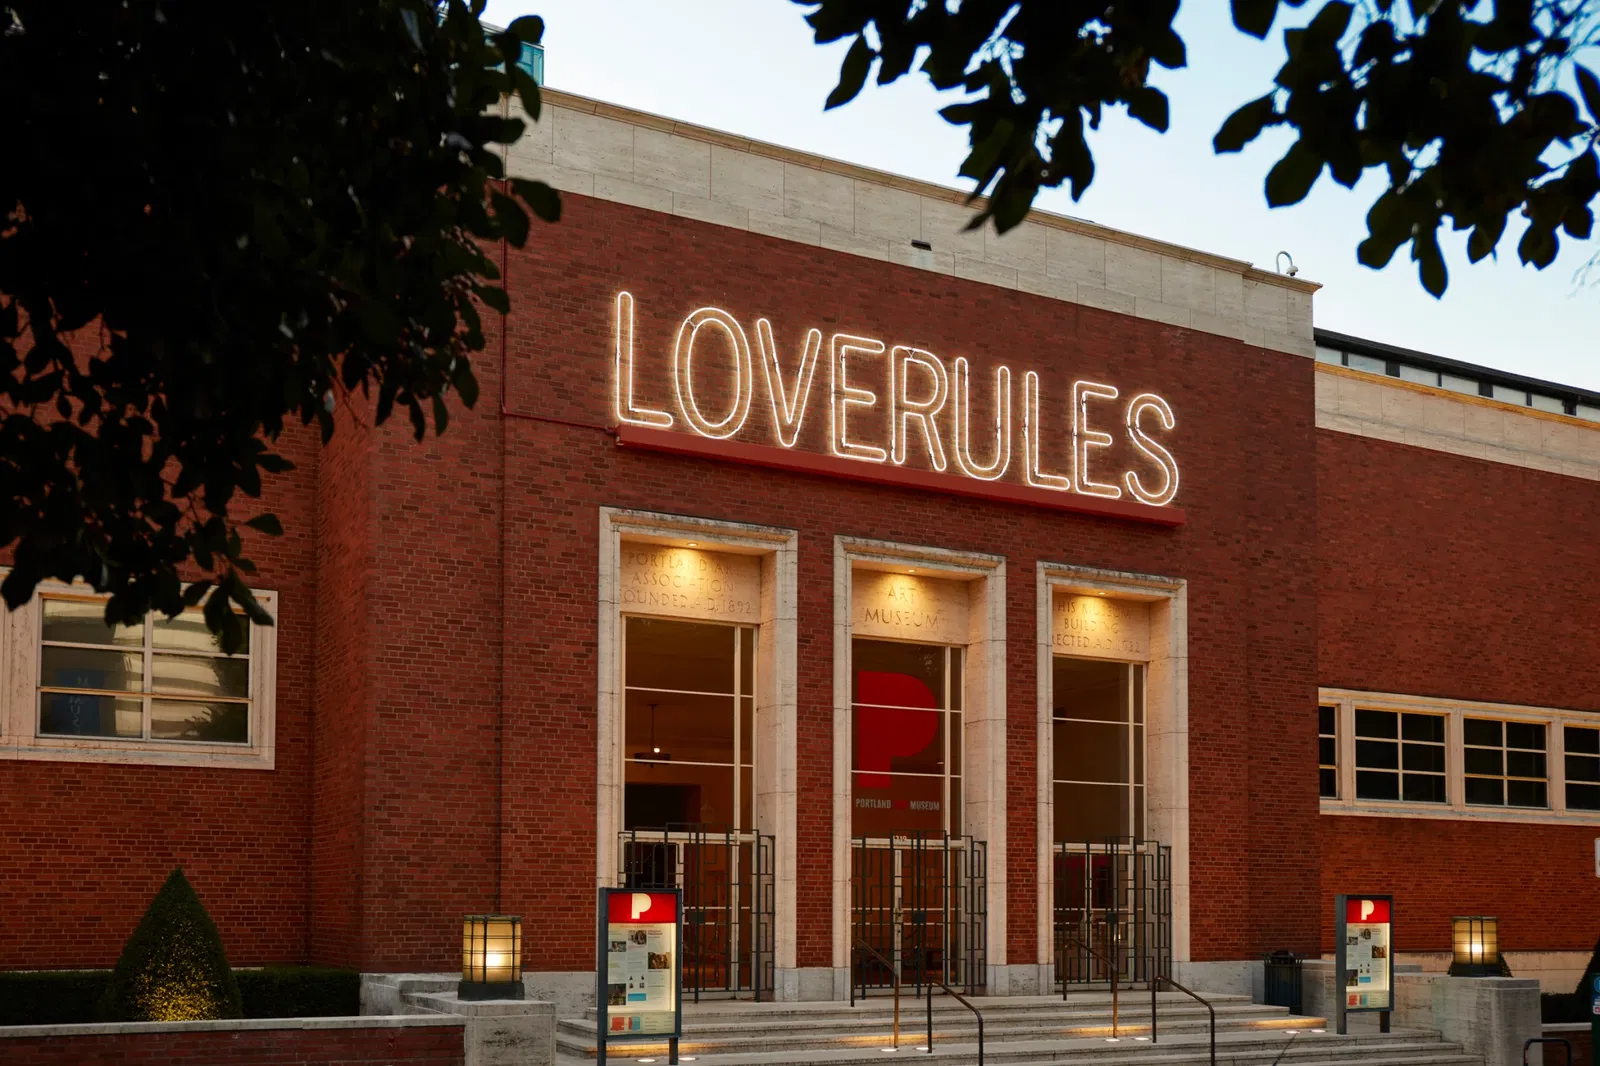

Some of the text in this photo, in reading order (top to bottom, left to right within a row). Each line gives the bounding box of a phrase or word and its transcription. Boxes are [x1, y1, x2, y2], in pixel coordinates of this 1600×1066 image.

[628, 553, 708, 571] PORTLAND
[631, 572, 735, 593] ASSOCTION
[620, 589, 688, 608] OUNDED
[887, 584, 917, 605] ART
[864, 607, 940, 630] MUSEUM
[1063, 618, 1120, 635] BUILDNG
[1052, 633, 1090, 648] RECTED
[855, 798, 892, 809] PORTLAND
[909, 800, 940, 811] MUSEUM
[631, 893, 652, 919] P
[1361, 900, 1375, 920] P
